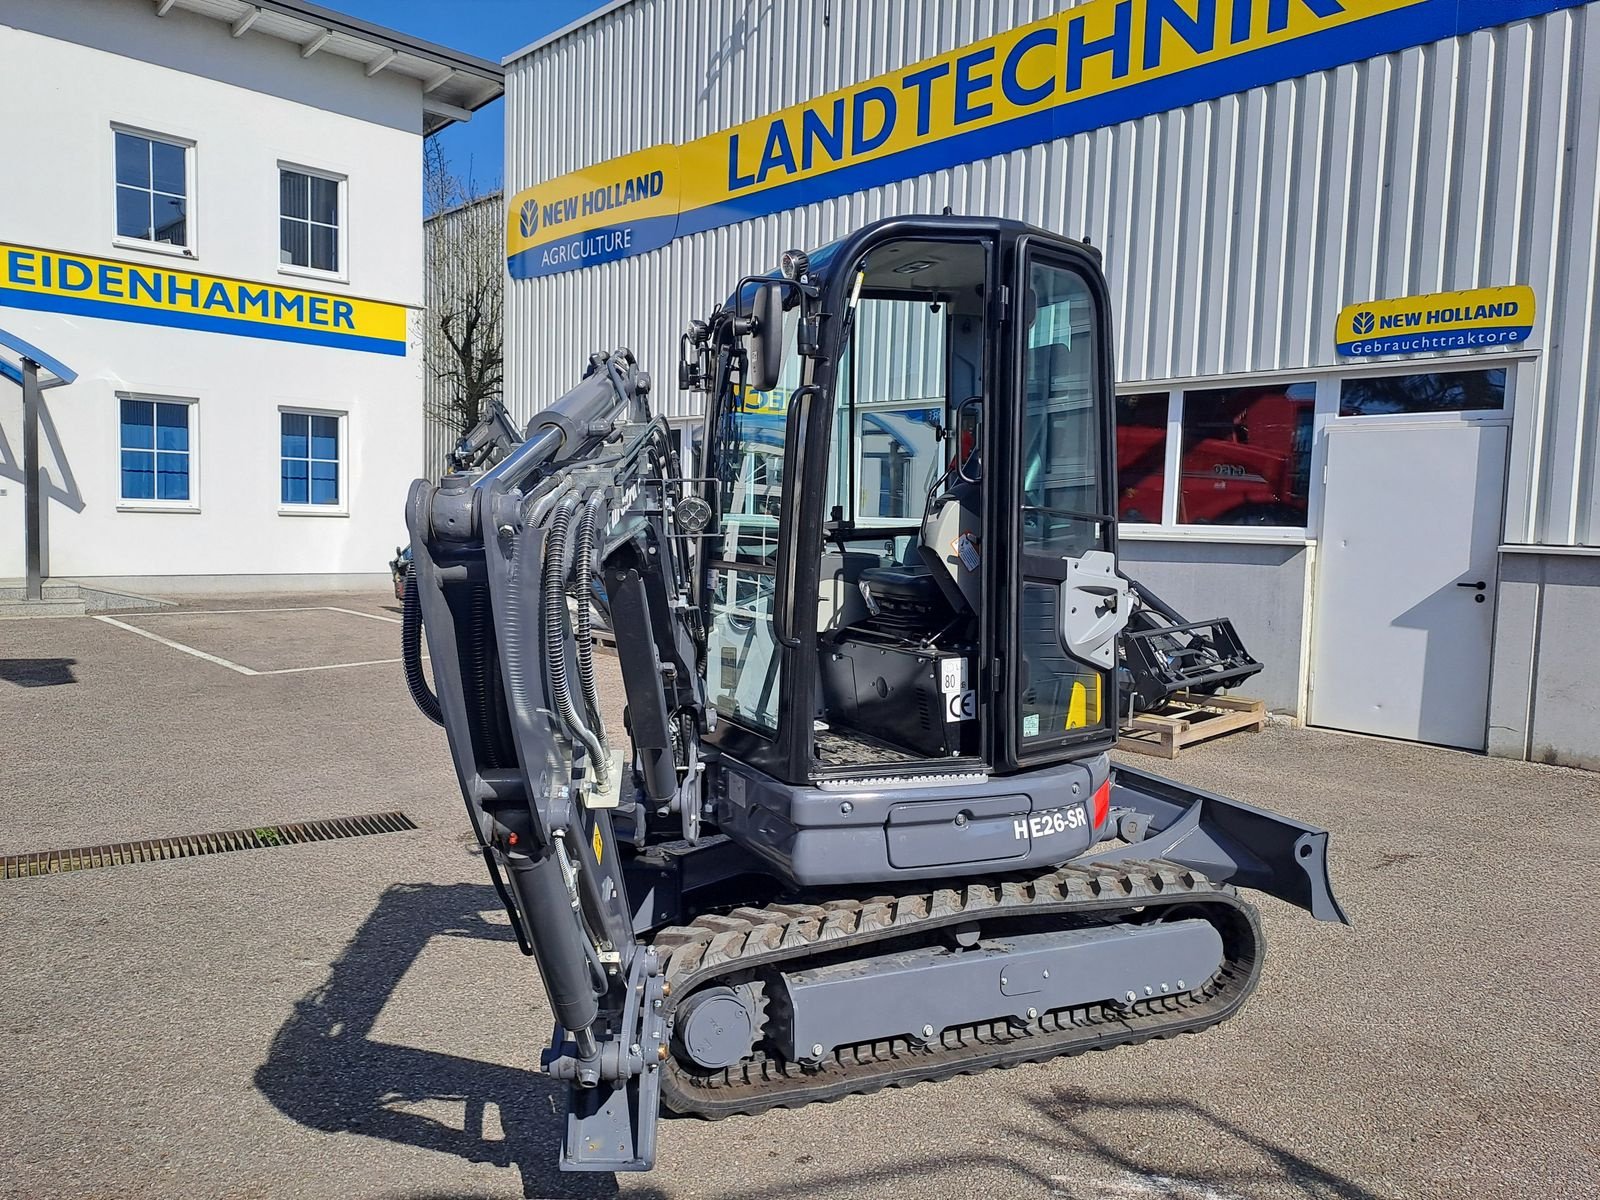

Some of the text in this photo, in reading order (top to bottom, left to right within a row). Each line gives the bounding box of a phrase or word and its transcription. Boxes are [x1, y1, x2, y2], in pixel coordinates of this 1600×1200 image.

[542, 170, 664, 228] NEW HOLLAND
[541, 228, 631, 267] AGRICULTURE
[8, 250, 356, 330] EIDENHAMMER
[1379, 301, 1519, 329] NEW HOLLAND
[1351, 331, 1519, 355] Gebrauchttraktore
[944, 674, 956, 689] 80
[1013, 808, 1087, 840] HE26-SR
